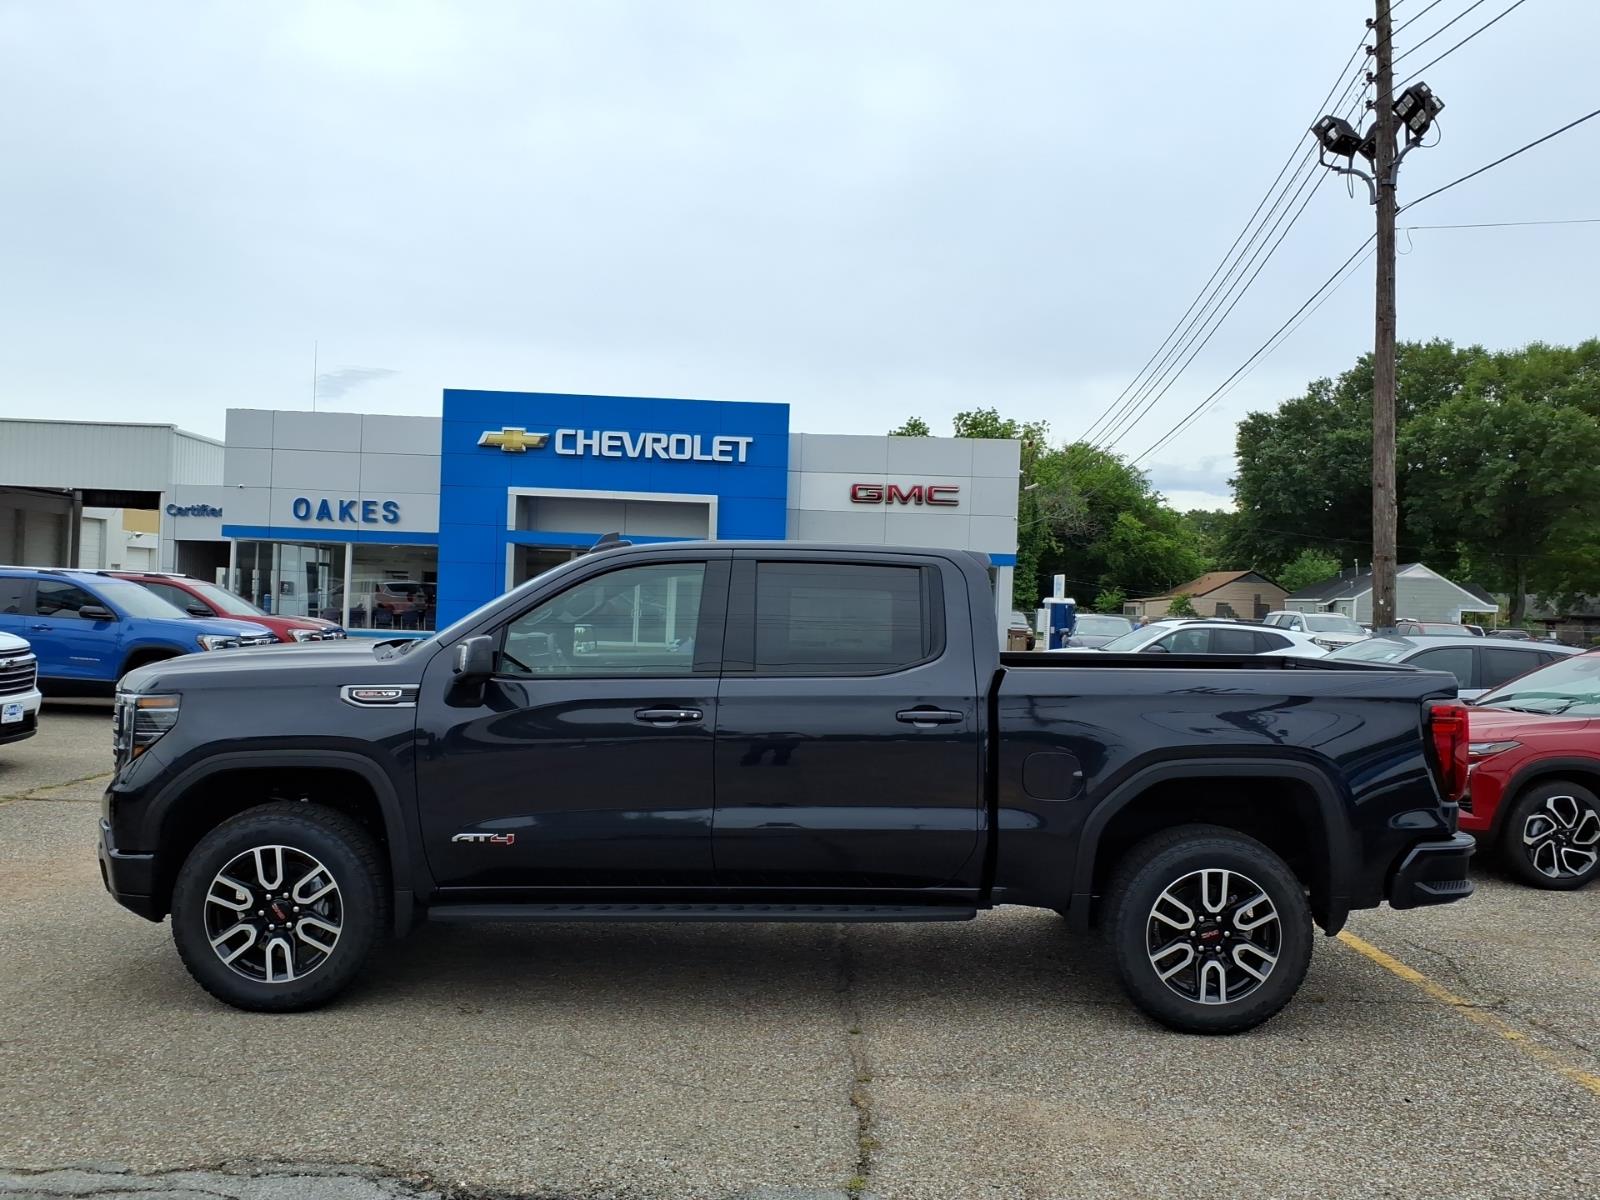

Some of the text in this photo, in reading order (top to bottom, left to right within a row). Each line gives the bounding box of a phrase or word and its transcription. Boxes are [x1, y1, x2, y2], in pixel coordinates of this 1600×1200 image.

[555, 428, 754, 463] CHEVROLET
[850, 483, 960, 506] GMC
[293, 497, 400, 525] OAKES
[451, 833, 515, 845] AT4
